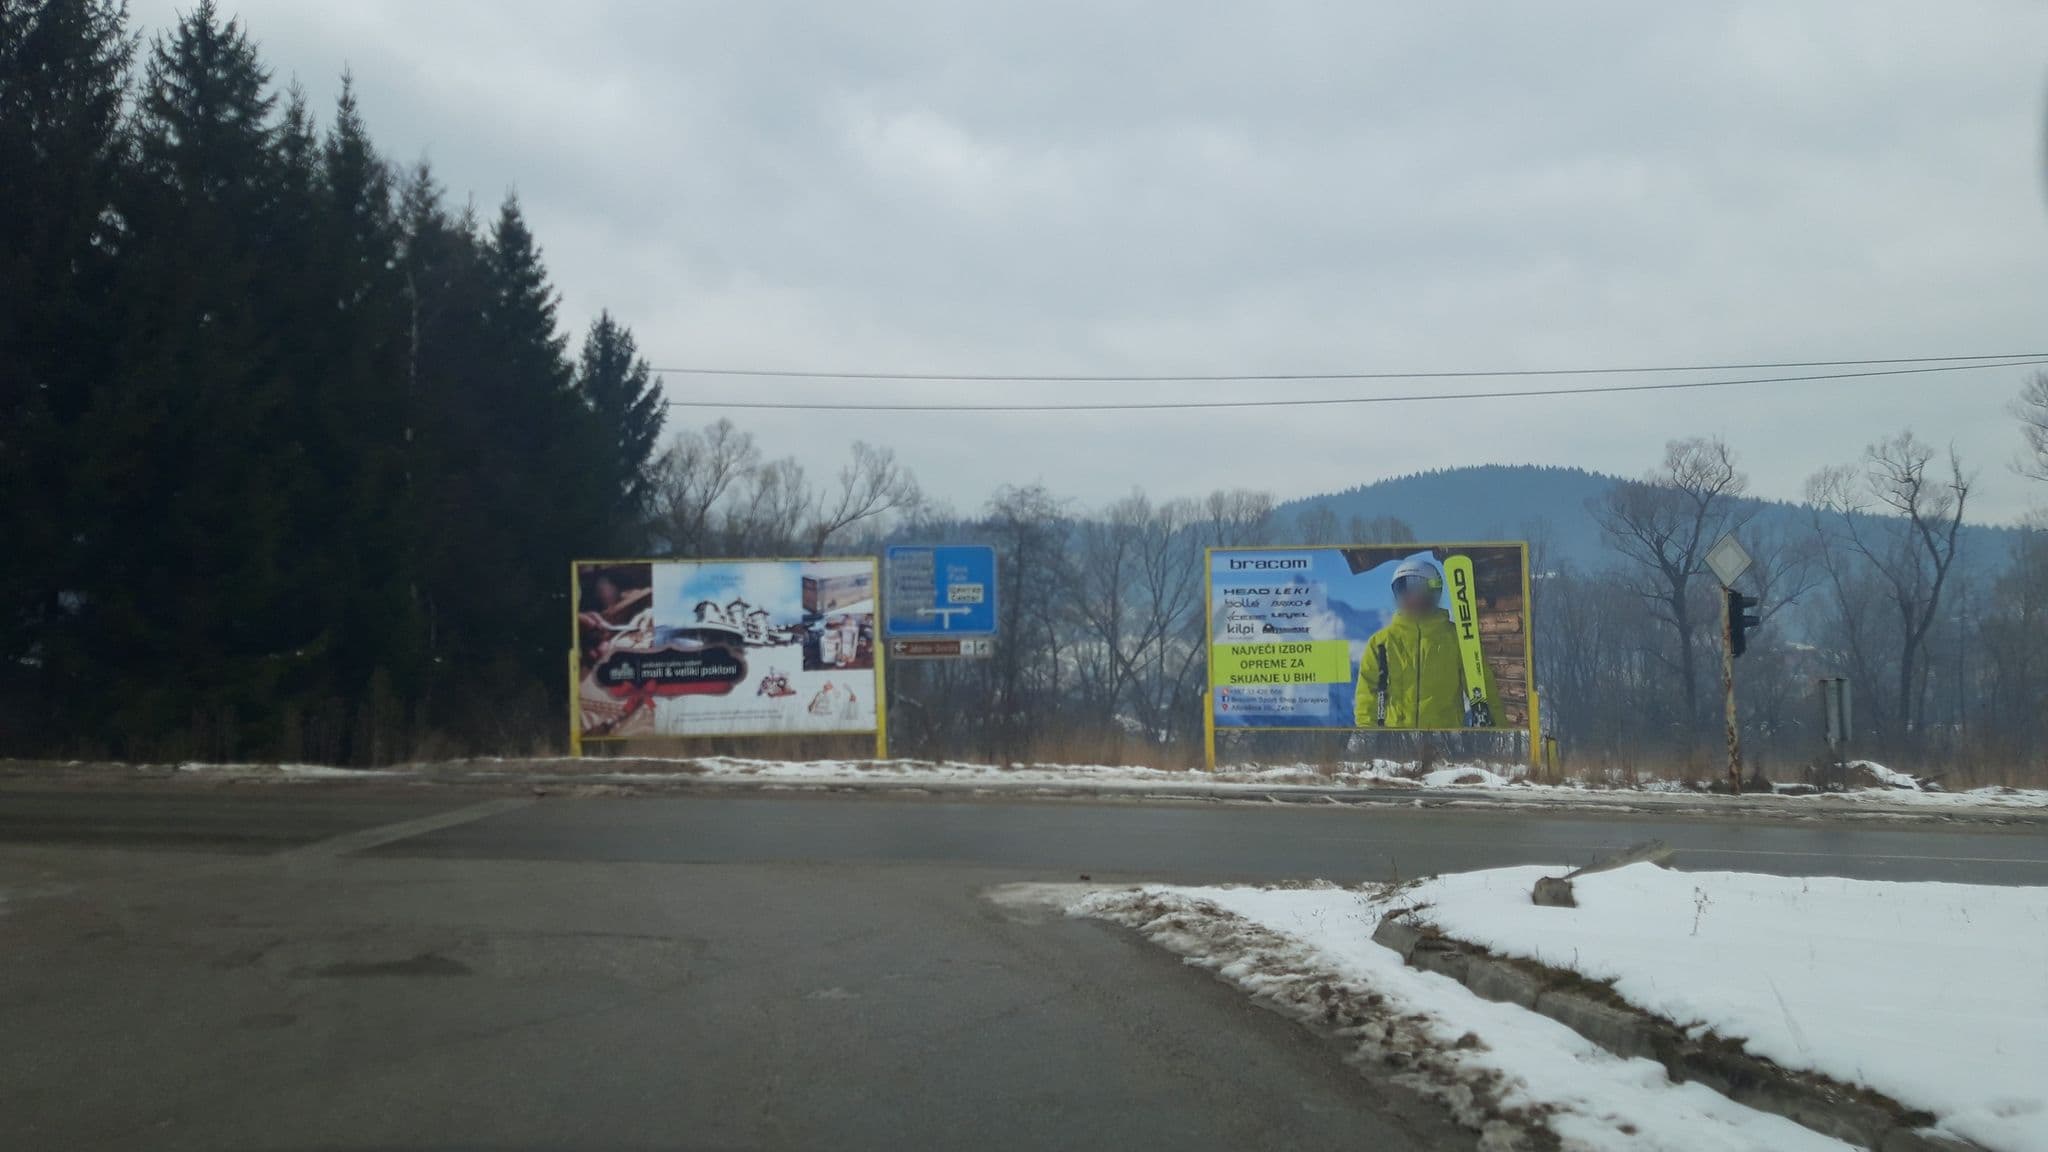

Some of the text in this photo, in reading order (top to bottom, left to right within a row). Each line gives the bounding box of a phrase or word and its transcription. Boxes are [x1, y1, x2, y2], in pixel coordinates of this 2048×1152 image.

[1230, 559, 1307, 570] bracom
[1275, 587, 1310, 595] LEKI
[1454, 568, 1474, 640] HEAD
[1227, 623, 1254, 635] kilpi
[1231, 643, 1312, 655] NAJVEĆI IZBOR
[1240, 659, 1305, 670] OPREME ZA
[1283, 673, 1291, 682] U
